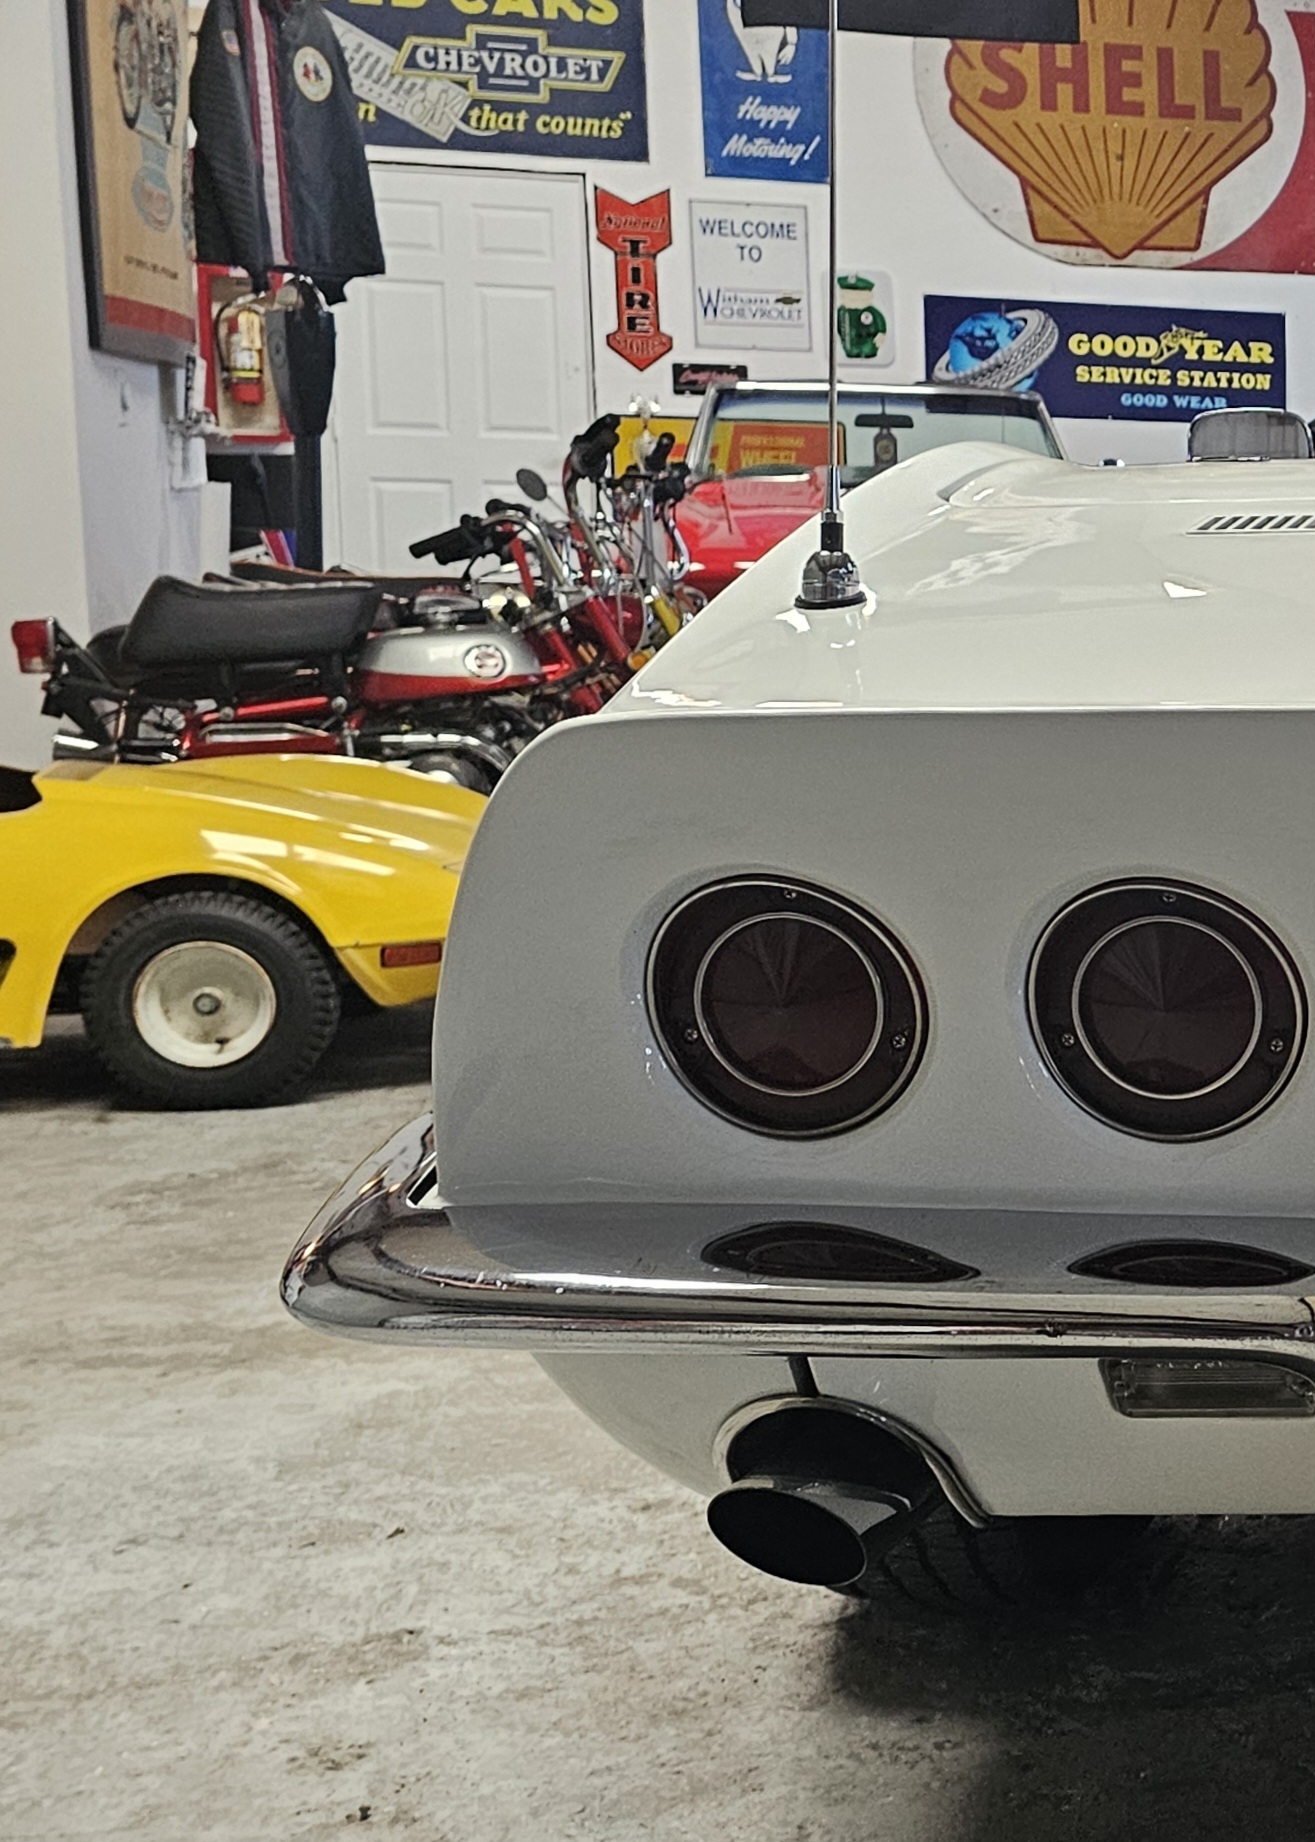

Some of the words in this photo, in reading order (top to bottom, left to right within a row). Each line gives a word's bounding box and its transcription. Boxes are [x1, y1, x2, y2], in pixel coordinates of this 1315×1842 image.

[415, 46, 604, 82] CHEVROLET
[978, 40, 1243, 122] SHELL
[468, 103, 530, 131] that
[737, 95, 801, 131] Happy
[721, 132, 821, 166] Motoring!
[699, 217, 798, 241] WELCOME
[737, 244, 762, 263] TO
[621, 236, 653, 334] TIRE
[1075, 365, 1172, 387] SERVICE
[1176, 370, 1272, 391] STATION
[1120, 393, 1169, 409] GOOD
[1173, 395, 1228, 410] WEAR
